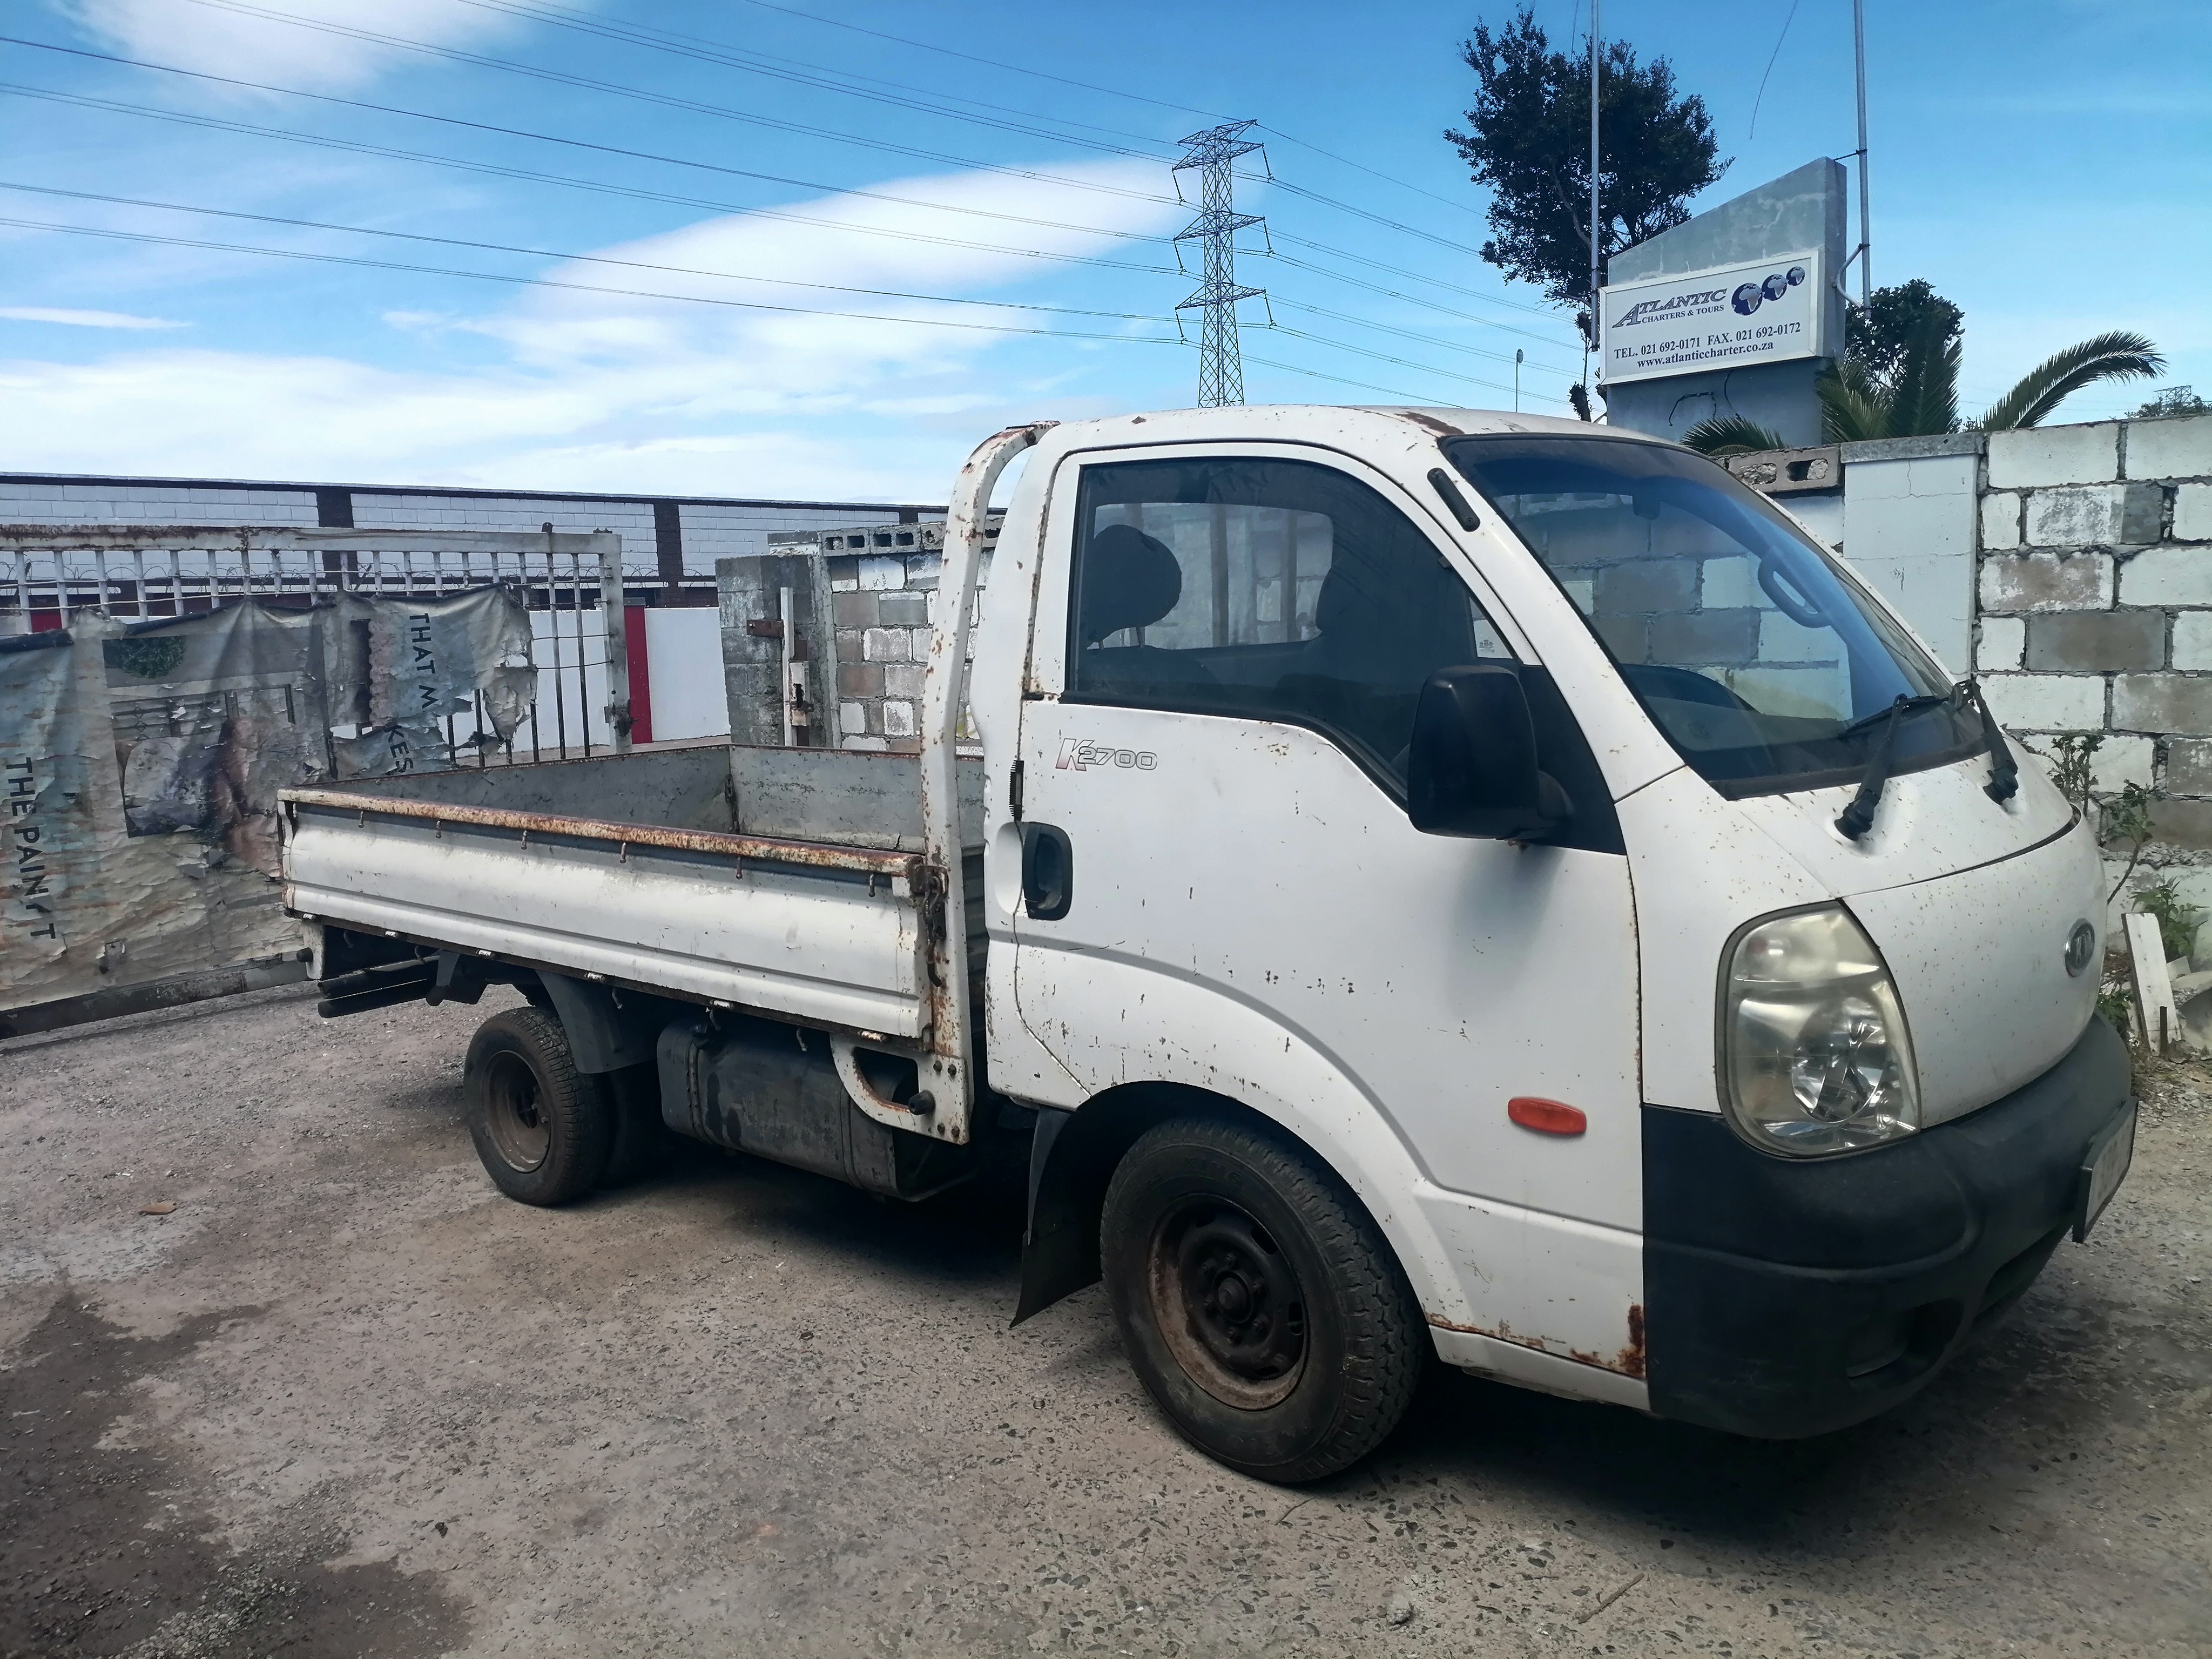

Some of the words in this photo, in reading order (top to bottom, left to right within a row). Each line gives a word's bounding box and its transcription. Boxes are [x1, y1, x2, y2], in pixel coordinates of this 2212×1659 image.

[1612, 288, 1728, 328] ATLANTIC
[1642, 311, 1685, 323] CHARTERS
[1696, 305, 1724, 315] TOURS
[1614, 346, 1638, 360] TEL.
[1641, 343, 1656, 355] 021
[1660, 336, 1701, 353] 692-0171
[1707, 332, 1732, 346] FAX.
[1736, 329, 1752, 341] 021
[1756, 322, 1801, 339] 692-0172
[1637, 341, 1774, 368] www.atlanticcharter.co.za
[409, 612, 435, 675] THAT
[1055, 738, 1158, 772] K2700
[6, 757, 37, 817] THE
